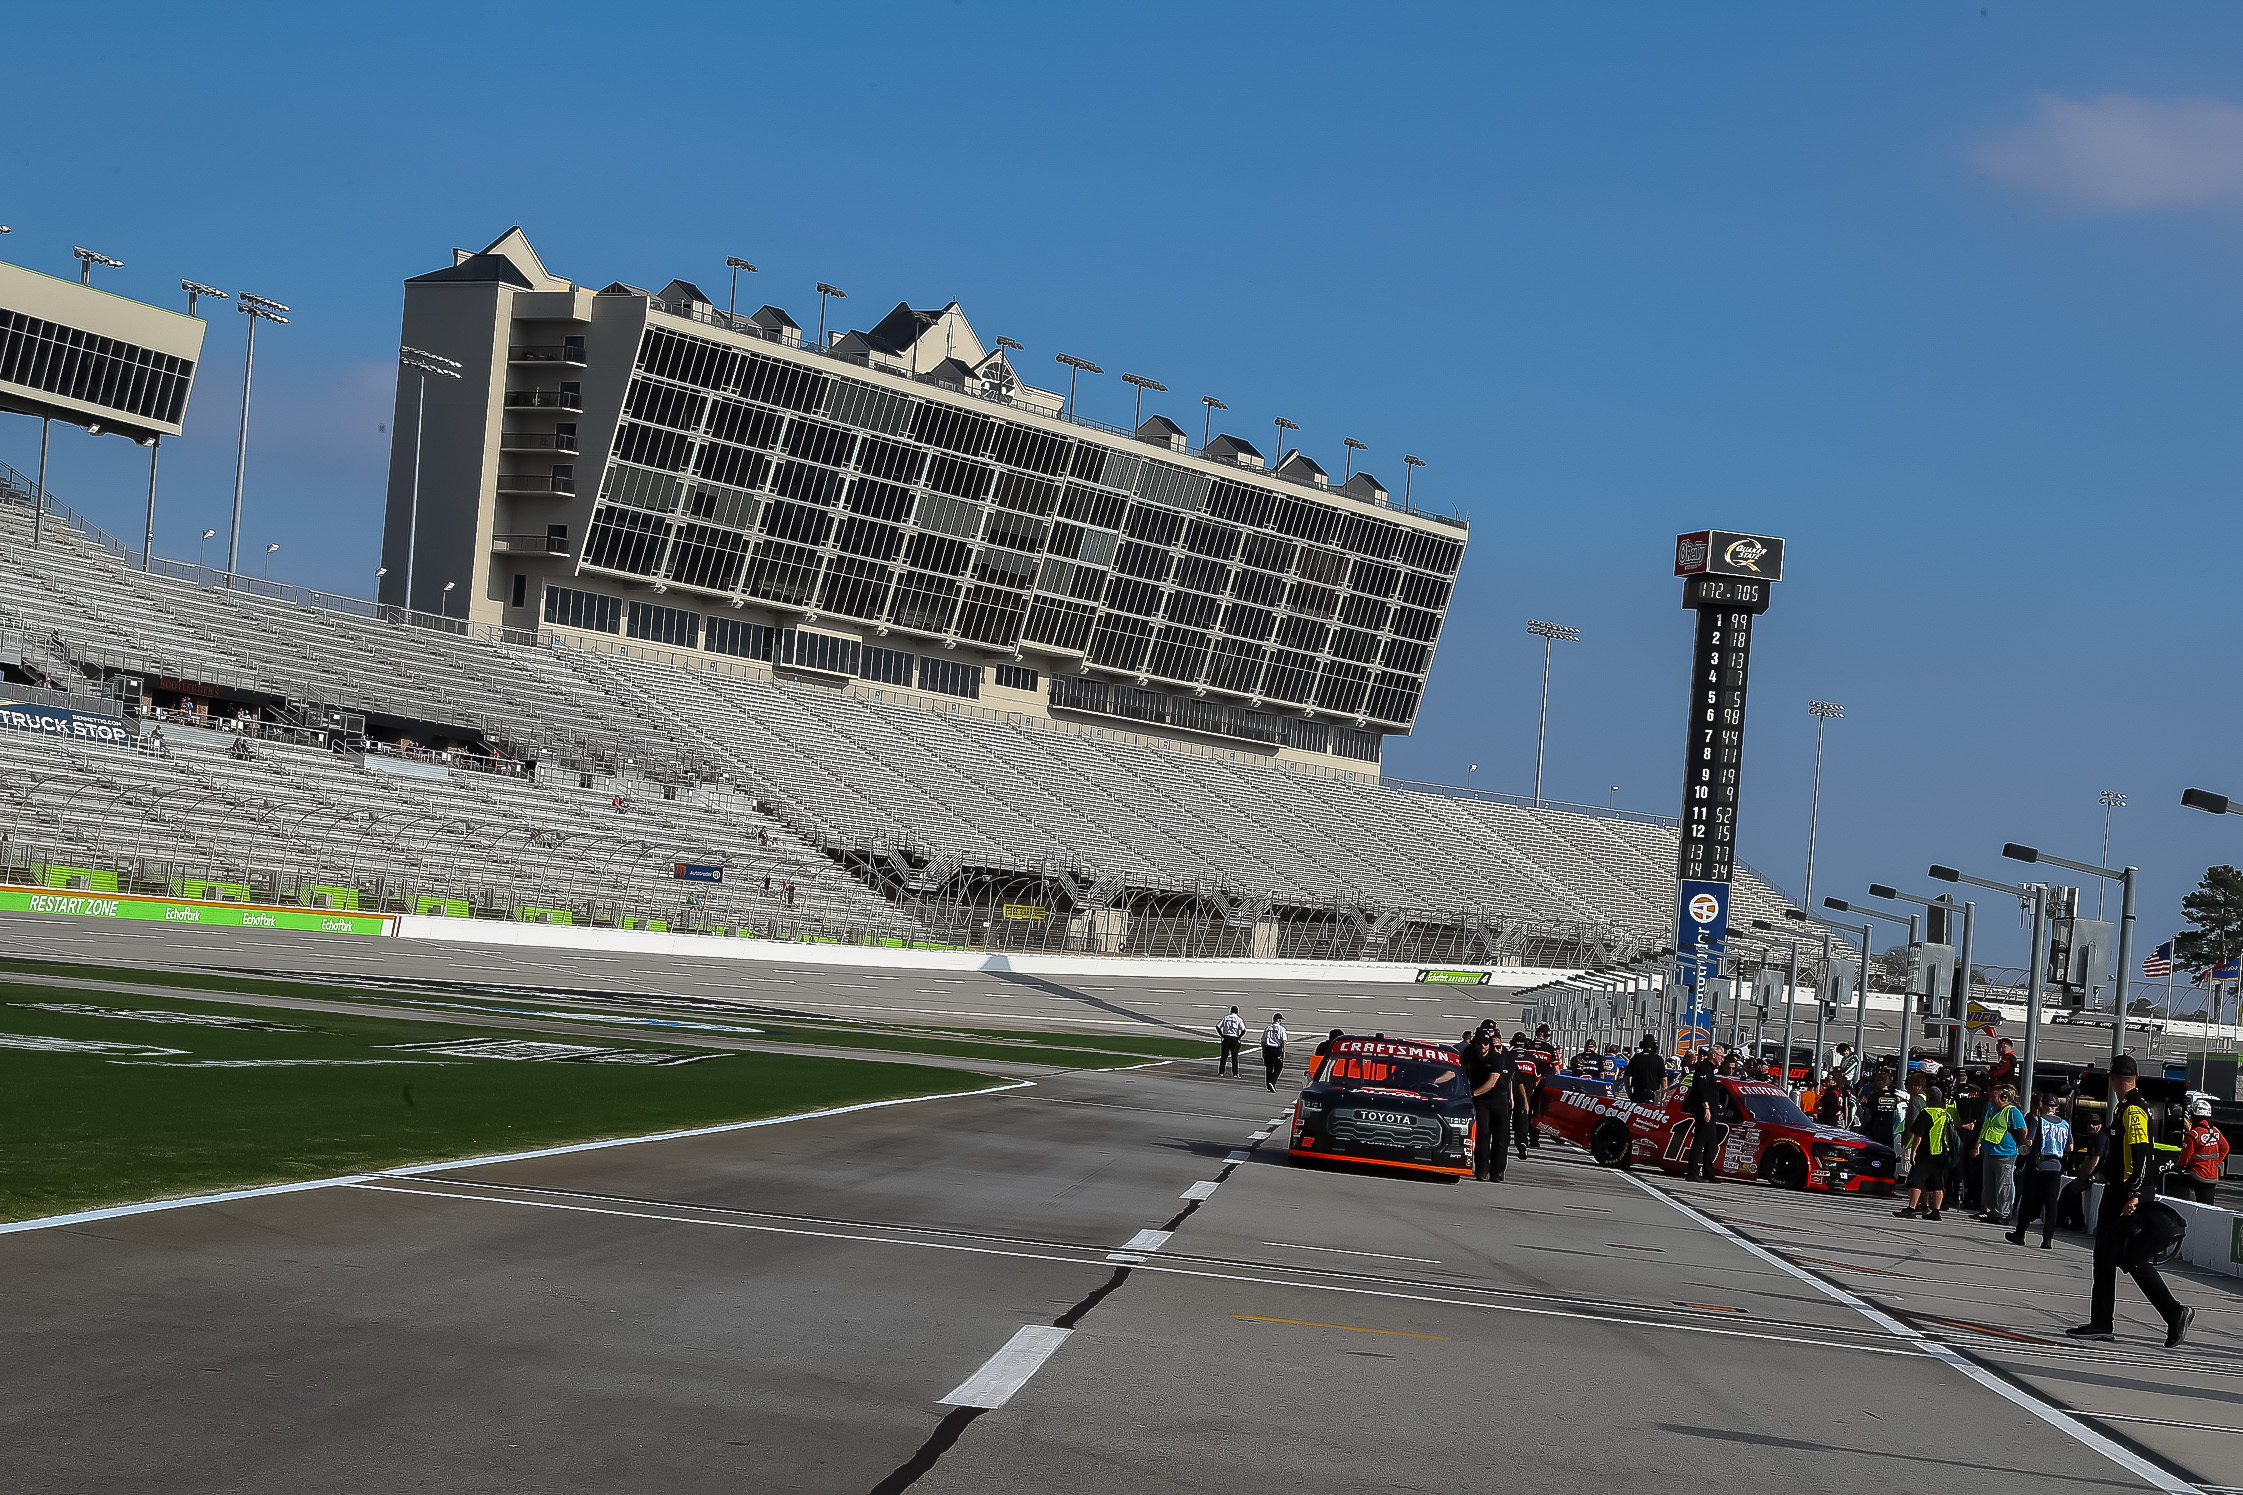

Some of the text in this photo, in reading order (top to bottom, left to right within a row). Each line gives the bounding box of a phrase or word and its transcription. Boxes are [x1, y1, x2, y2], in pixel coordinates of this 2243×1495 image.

[1735, 544, 1767, 555] QUAKER
[1702, 582, 1759, 602] 172.705
[1716, 613, 1748, 630] 1 99
[1711, 631, 1746, 648] 2 18
[1710, 652, 1745, 669] 3 13
[1708, 669, 1743, 686] 4 7
[1707, 690, 1741, 708] 5 5
[0, 709, 126, 741] TRUCK STOP
[1706, 708, 1740, 725] 6 98
[1704, 729, 1739, 746] 7 44
[1703, 747, 1737, 764] 8 11
[1701, 768, 1736, 784] 9 19
[1694, 785, 1735, 802] 10 9
[1692, 806, 1733, 824] 11 52
[1691, 824, 1731, 842] 12 15
[1690, 844, 1730, 862] 13 77
[1689, 862, 1728, 880] 14 34
[29, 895, 120, 917] RESTART ZONE
[165, 907, 201, 922] EchoPark
[242, 912, 276, 927] EchoPark
[321, 918, 354, 932] EchoPark
[1339, 1041, 1450, 1062] CRAFTSMAN
[1560, 1090, 1631, 1123] Tiltload
[1611, 1099, 1670, 1124] Atlantic
[1360, 1110, 1411, 1125] TOYOTA
